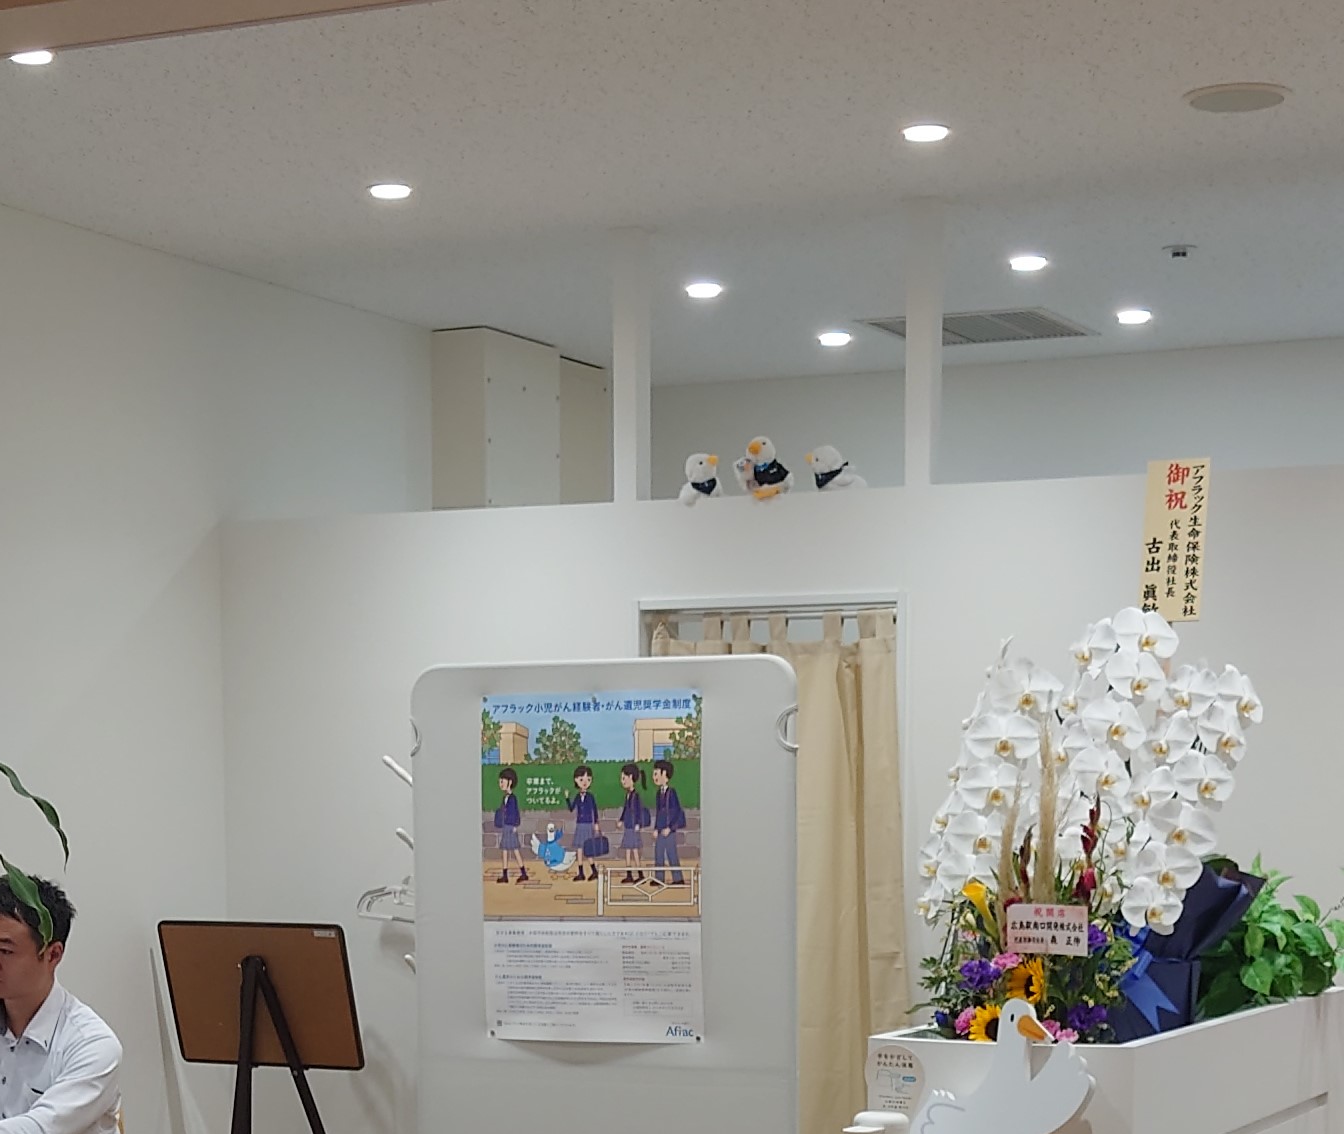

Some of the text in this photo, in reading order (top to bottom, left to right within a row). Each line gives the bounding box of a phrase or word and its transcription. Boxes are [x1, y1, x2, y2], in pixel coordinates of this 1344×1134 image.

[1165, 463, 1190, 511] 御祝
[1145, 537, 1163, 573] 古出
[1165, 519, 1181, 598] 代表取締役社長
[1182, 464, 1205, 617] アフラック生命保険株式会社
